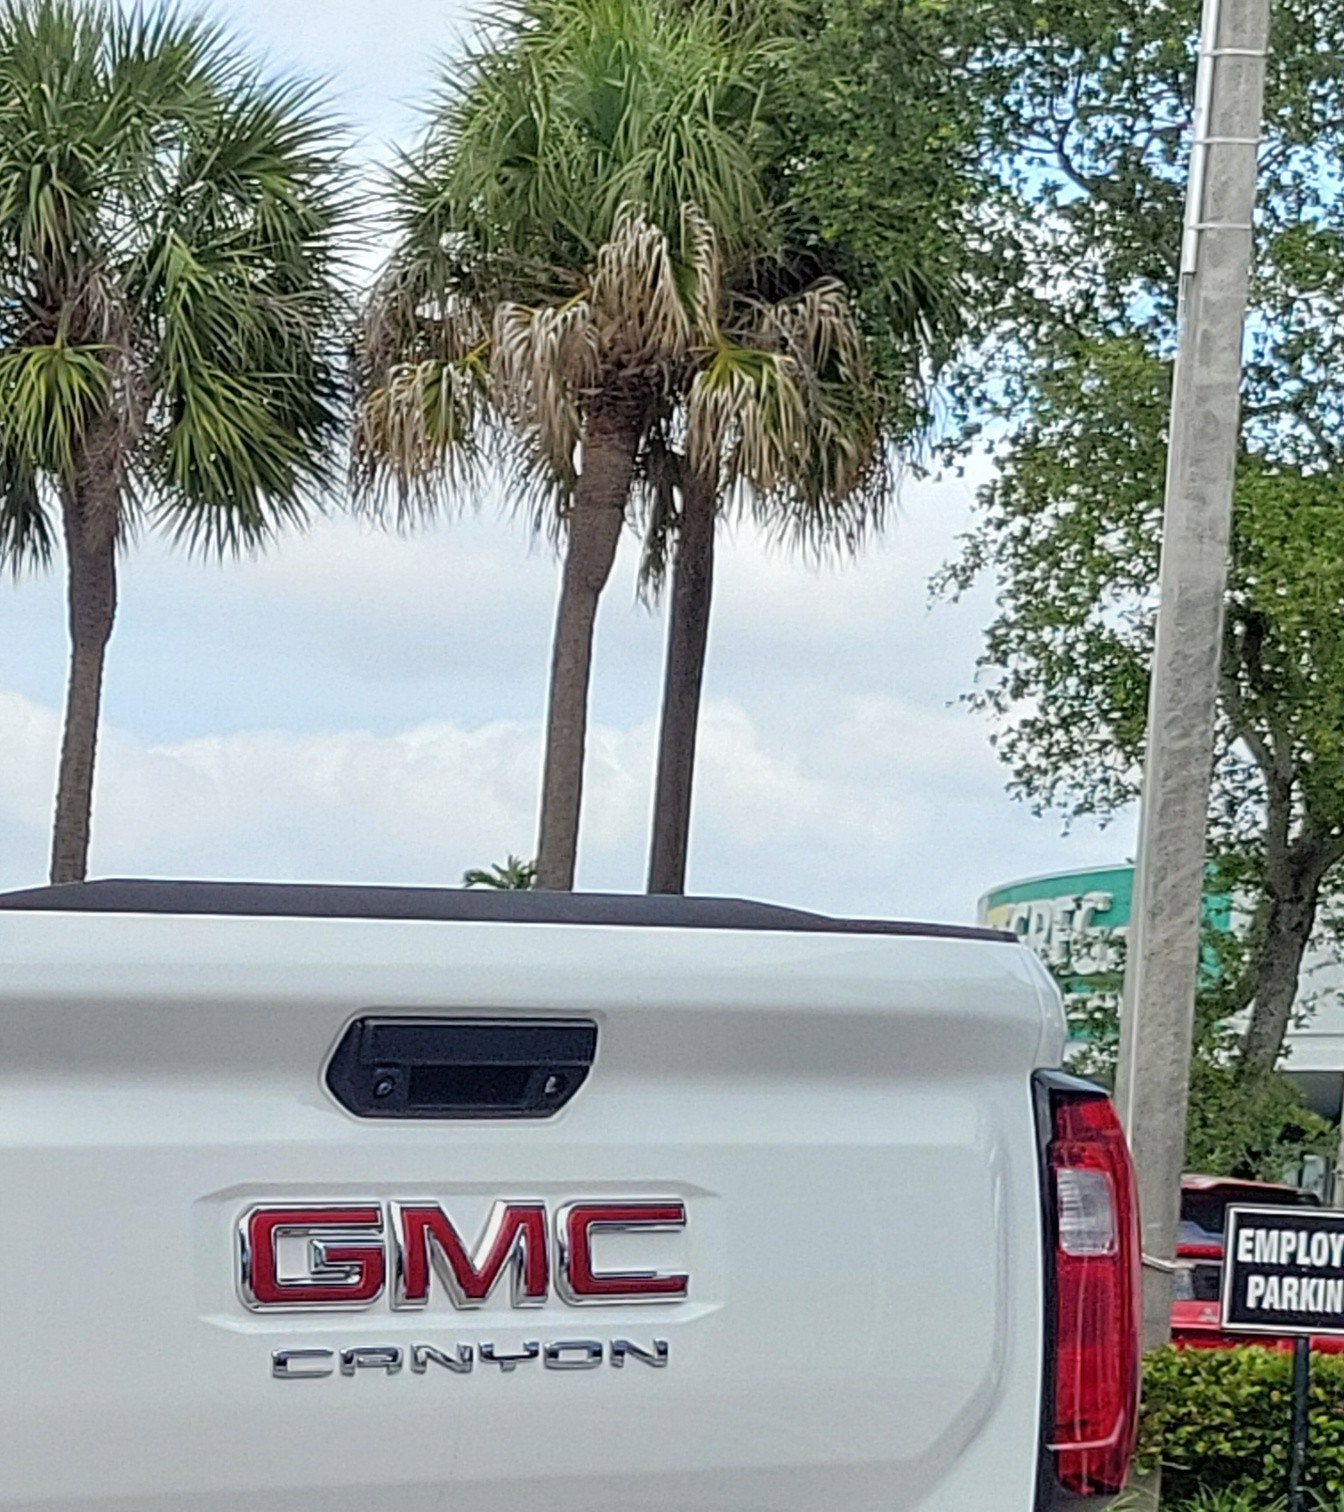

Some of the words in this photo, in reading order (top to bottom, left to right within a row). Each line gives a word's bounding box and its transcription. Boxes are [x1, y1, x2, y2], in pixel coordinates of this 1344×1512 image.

[236, 1199, 689, 1313] GMC
[1237, 1228, 1344, 1268] EMPLOY
[1246, 1274, 1343, 1313] PARKIN
[272, 1338, 669, 1379] CANYON
